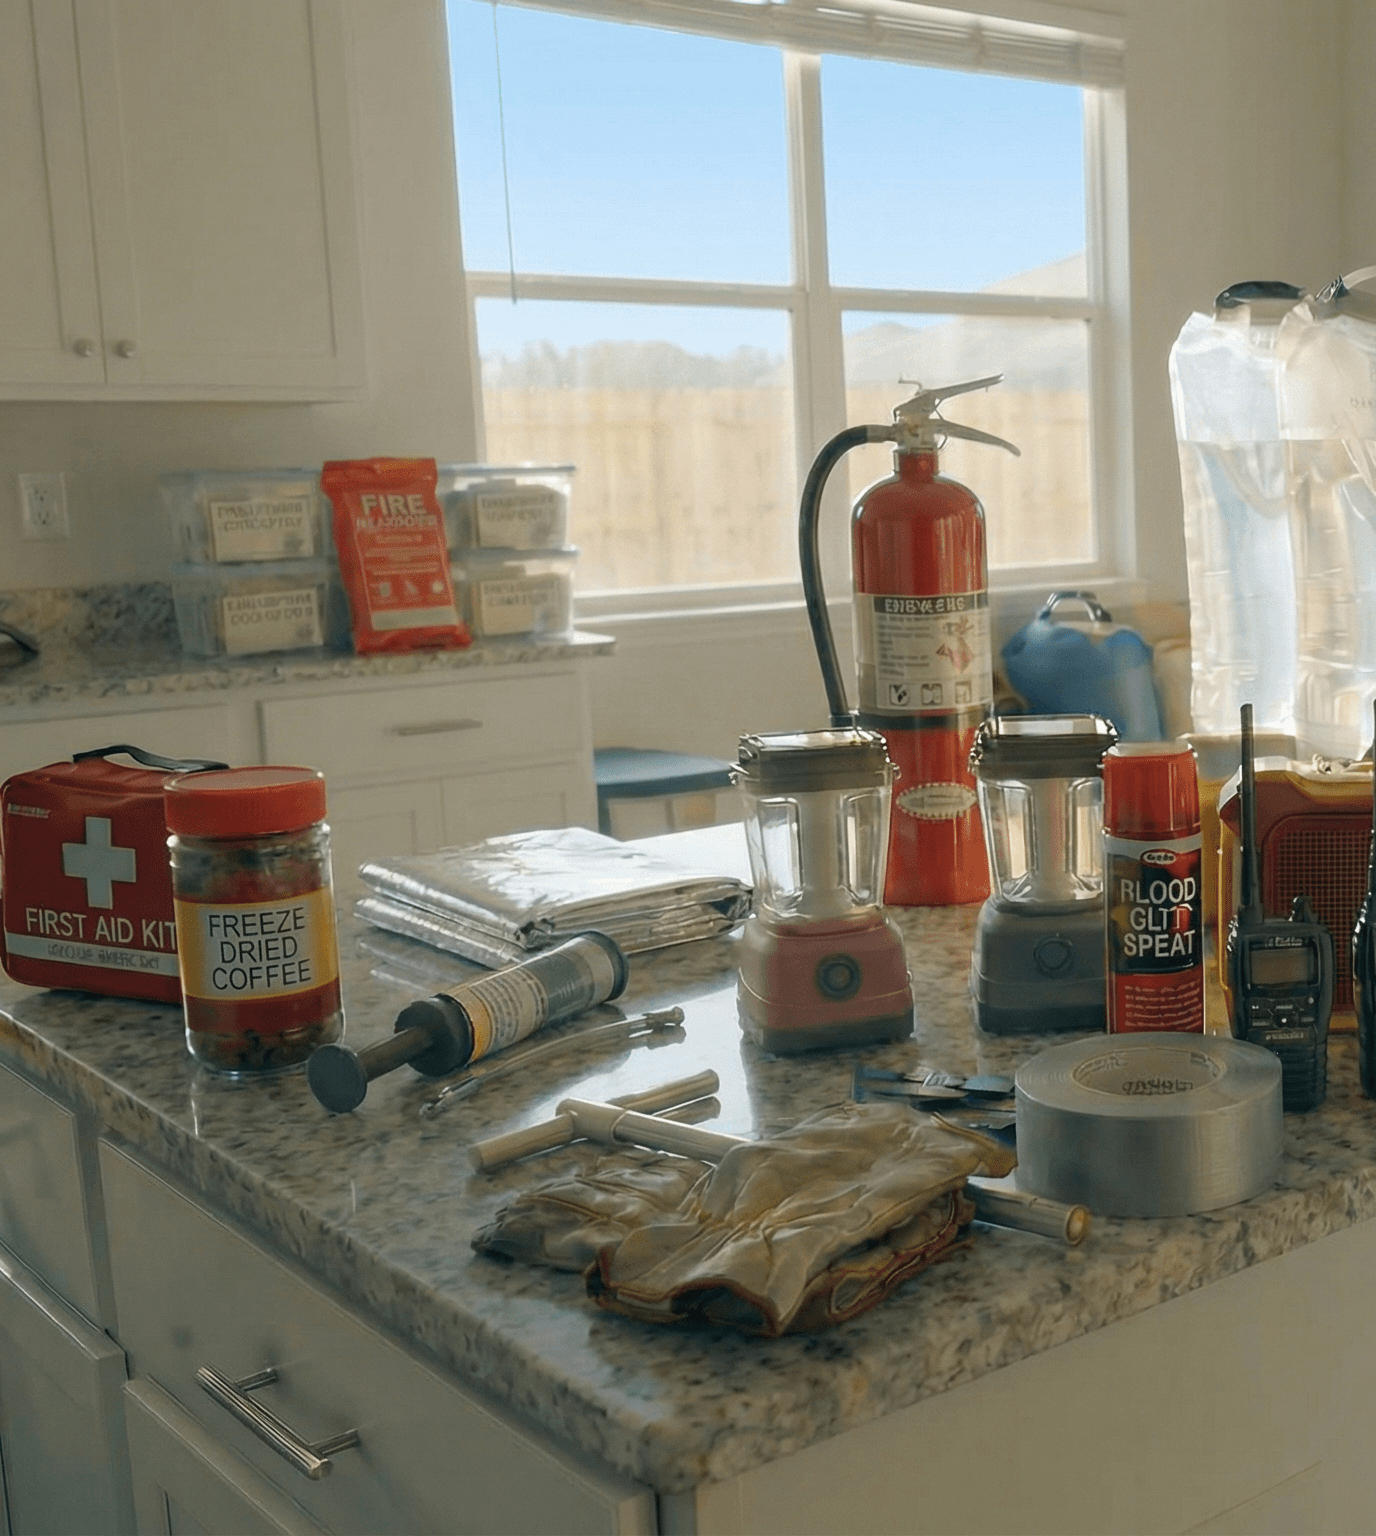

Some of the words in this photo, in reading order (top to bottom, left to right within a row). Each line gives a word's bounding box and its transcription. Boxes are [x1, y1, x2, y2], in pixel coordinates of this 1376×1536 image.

[361, 494, 426, 515] FIRE
[25, 907, 87, 939] FIRST
[95, 915, 134, 943] AID
[142, 919, 177, 950] KIT
[208, 907, 305, 938] FREEZE
[220, 936, 298, 964] DRIED
[1123, 929, 1195, 957] SPEAT
[212, 958, 311, 990] COFFEE
